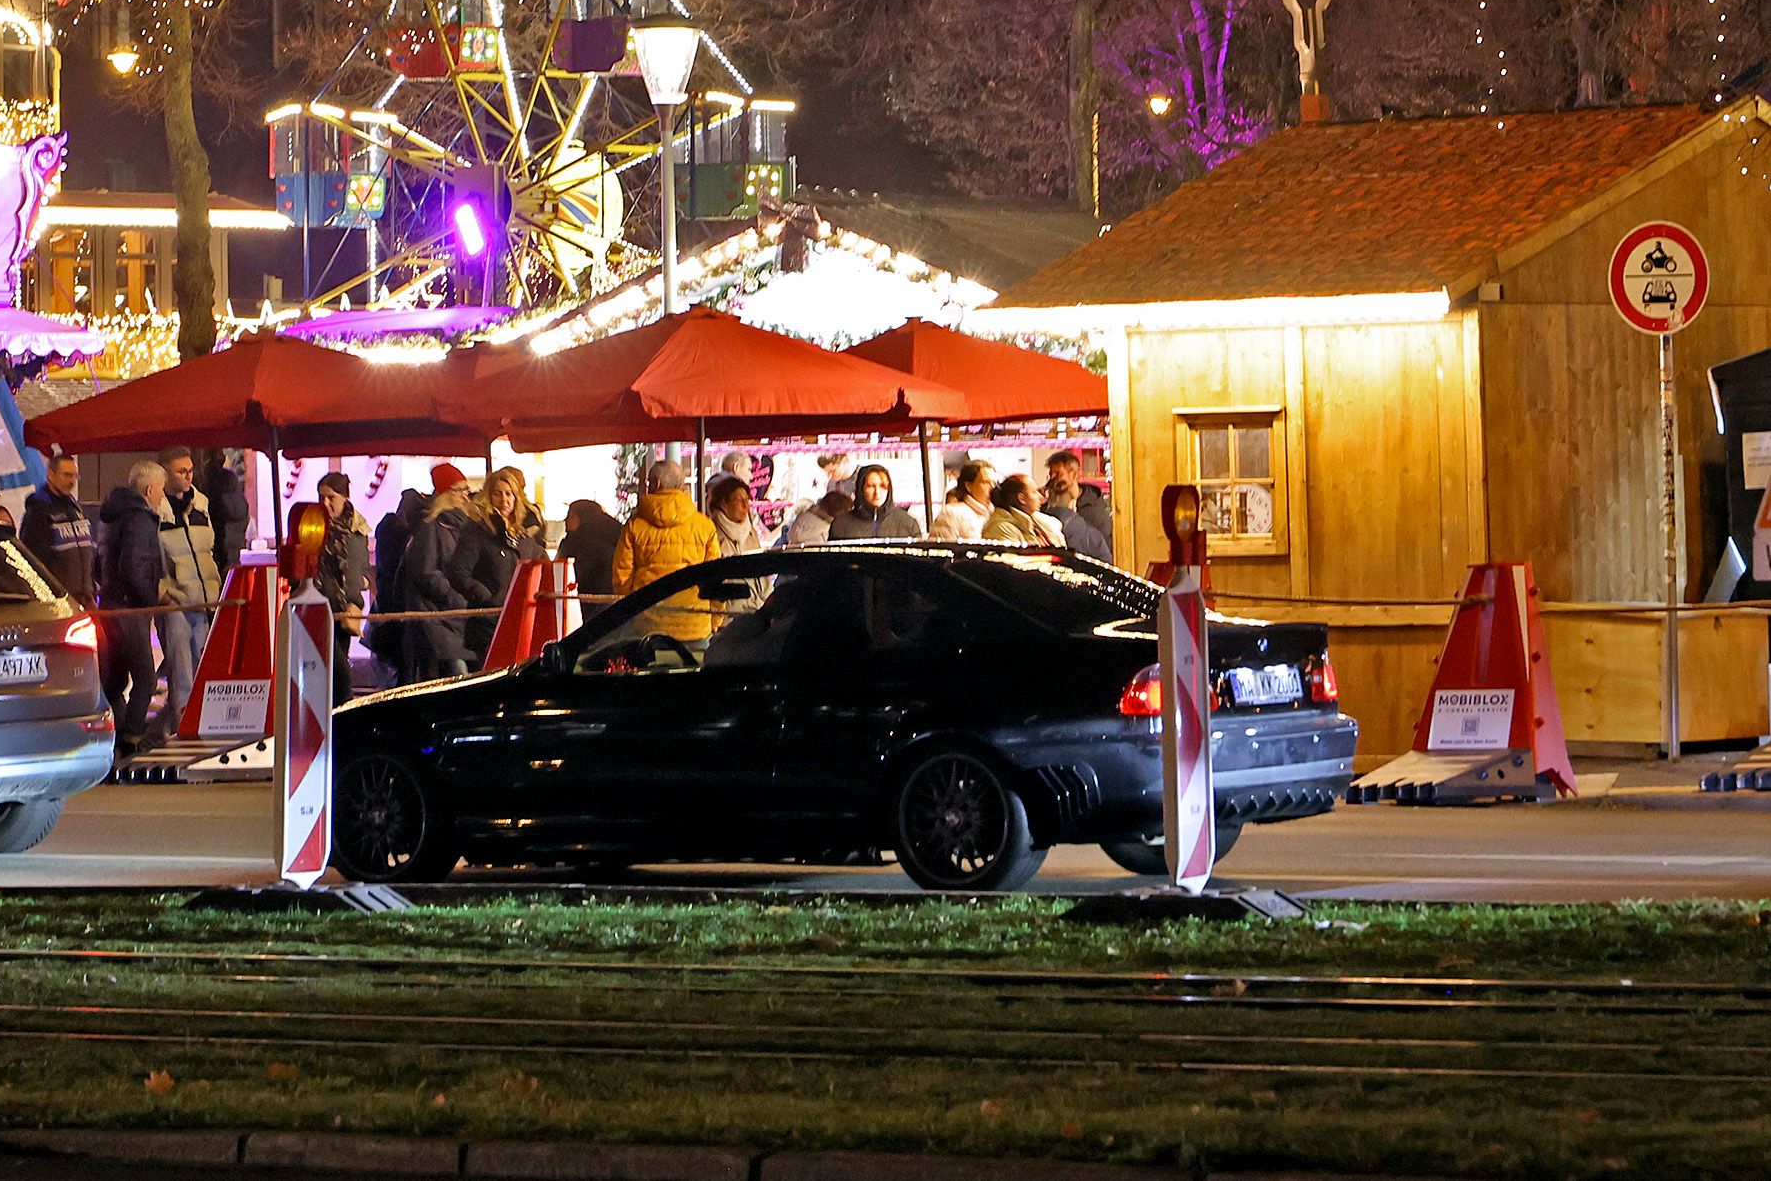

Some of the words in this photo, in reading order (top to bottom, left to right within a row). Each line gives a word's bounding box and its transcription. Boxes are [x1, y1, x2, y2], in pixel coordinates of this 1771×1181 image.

[28, 654, 45, 676] XK
[207, 683, 266, 696] MOBIBLOX
[1238, 676, 1255, 698] MA
[1438, 693, 1509, 706] MOBIBLOX
